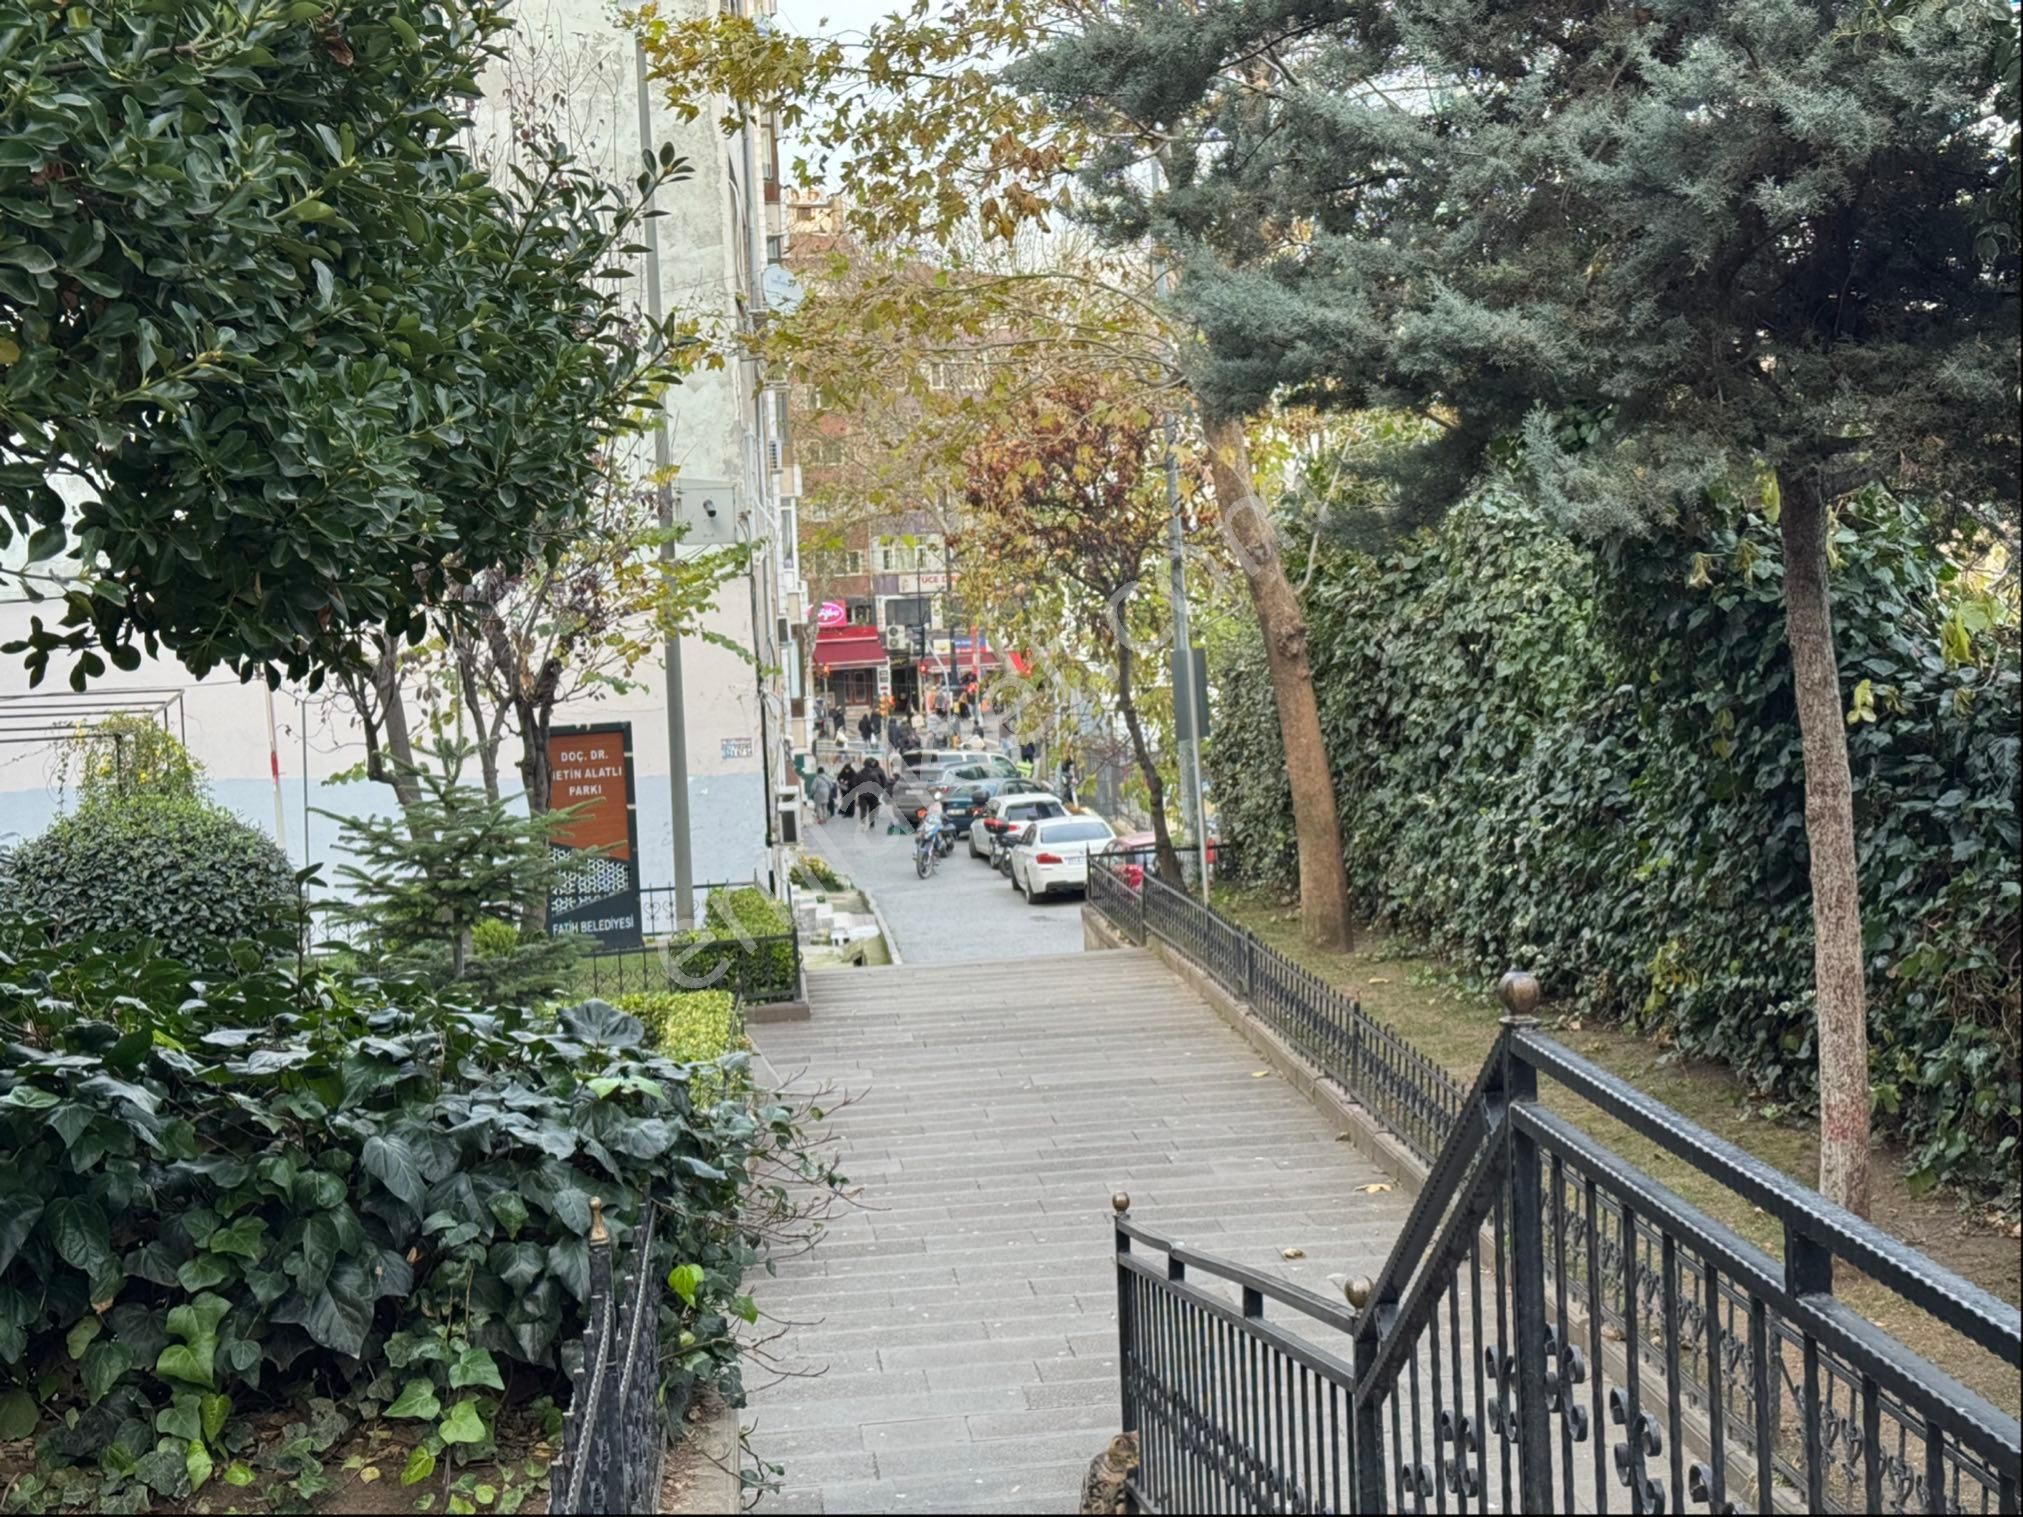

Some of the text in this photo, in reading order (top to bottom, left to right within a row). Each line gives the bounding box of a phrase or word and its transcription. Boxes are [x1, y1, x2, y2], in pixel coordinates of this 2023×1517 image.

[560, 749, 609, 764] DOÇ. DR.
[584, 766, 622, 777] ALATLI
[569, 784, 602, 796] PARKI
[552, 914, 634, 936] FATİH BELEDİYESİ
